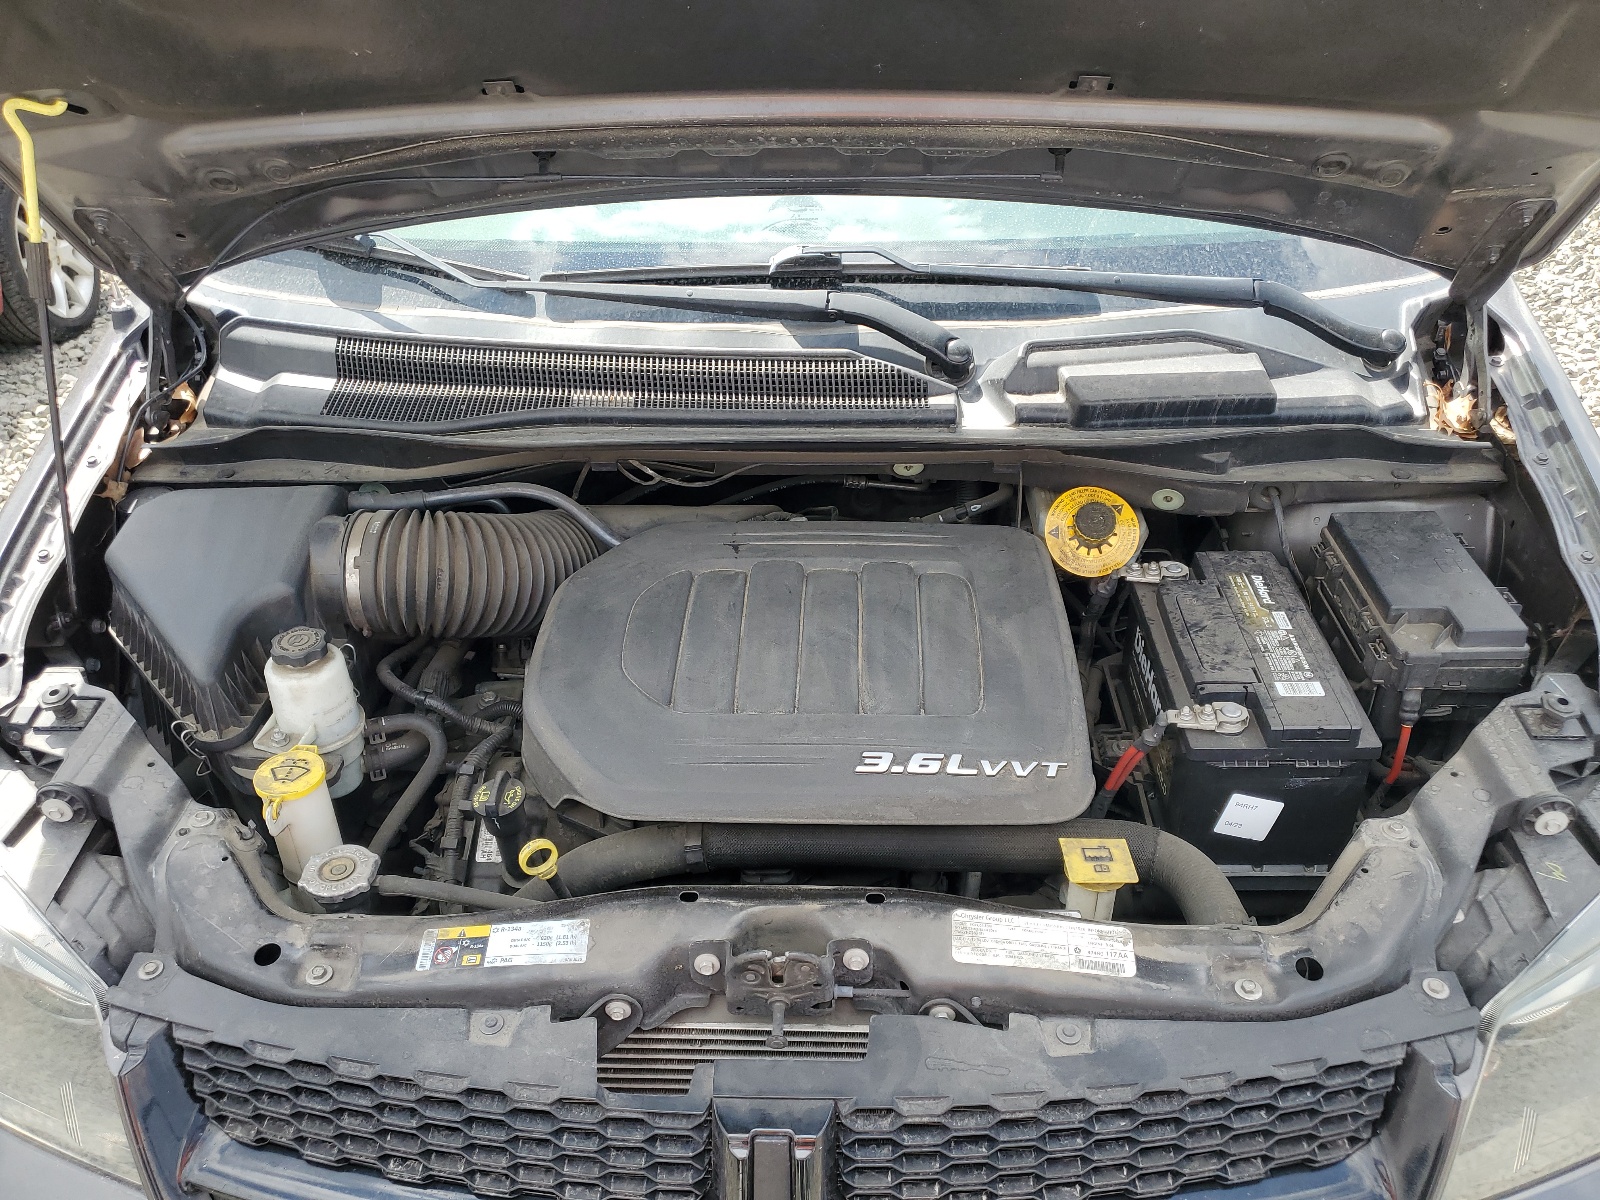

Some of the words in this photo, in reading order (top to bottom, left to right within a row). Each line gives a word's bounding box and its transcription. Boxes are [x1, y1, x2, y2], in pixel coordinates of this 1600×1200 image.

[1134, 625, 1162, 716] DieHar
[855, 751, 979, 776] 3.6L
[980, 759, 1068, 779] VVT
[960, 912, 984, 921] Chrysler
[985, 914, 1003, 923] Group
